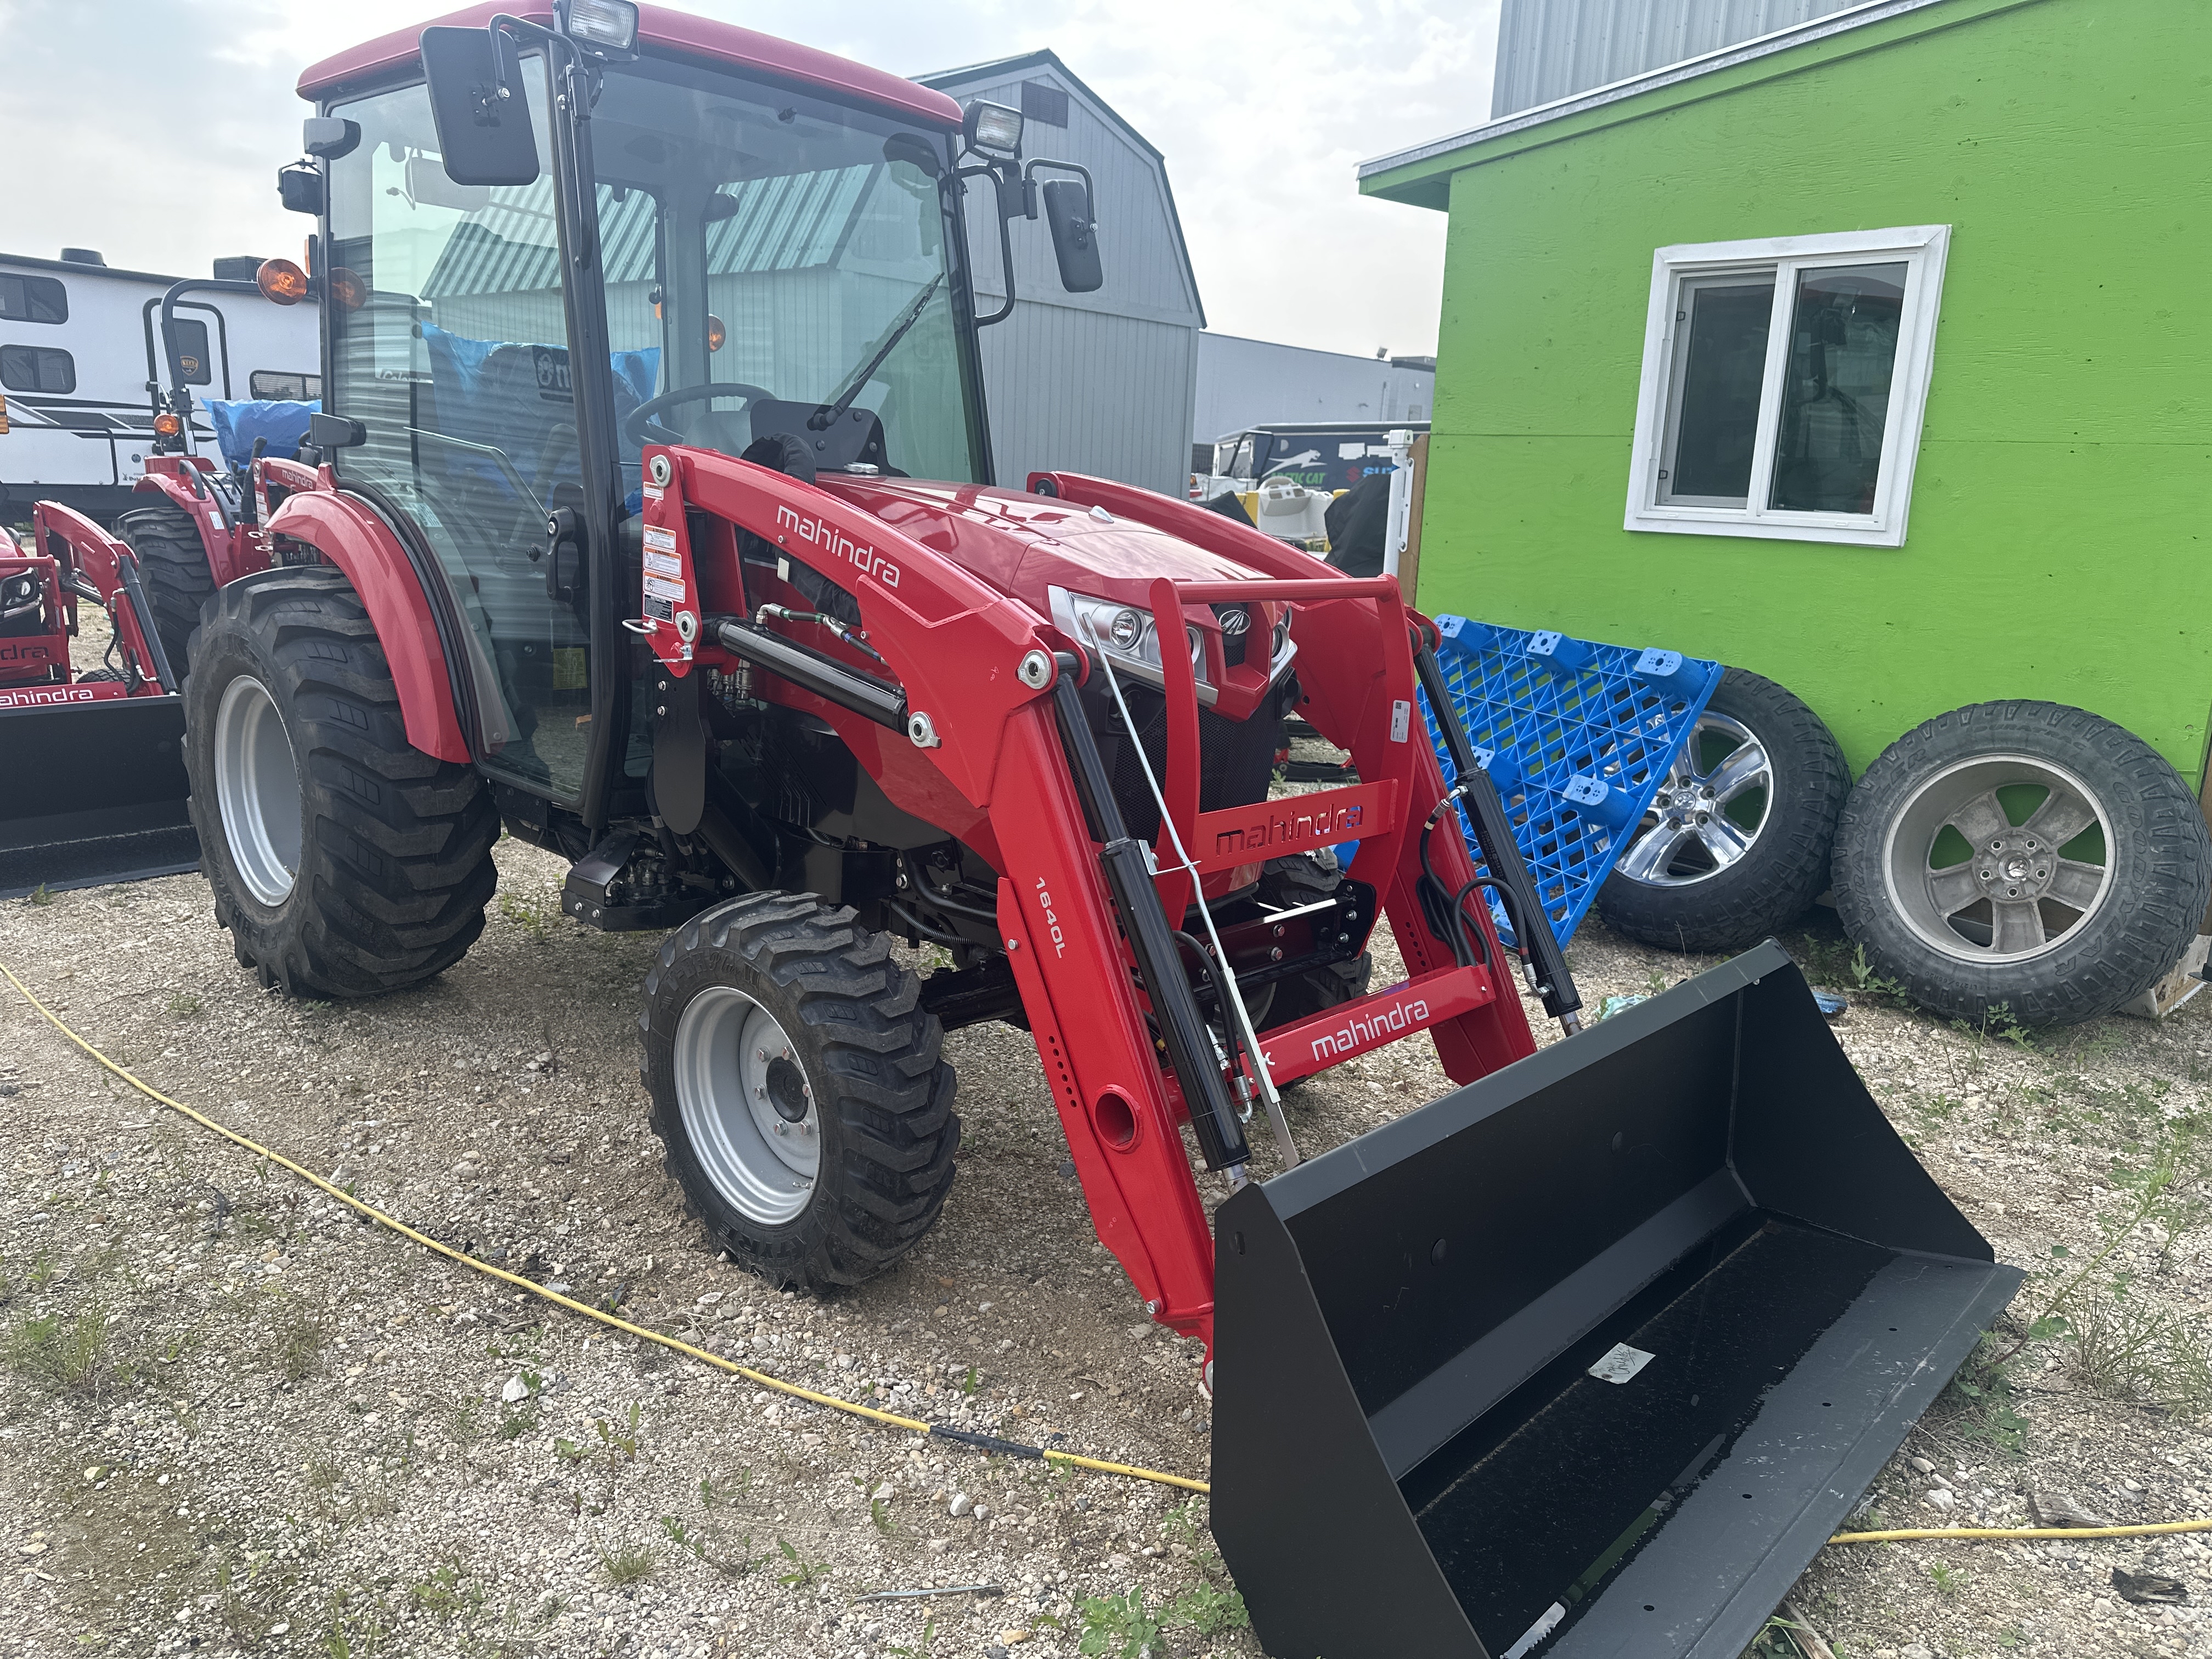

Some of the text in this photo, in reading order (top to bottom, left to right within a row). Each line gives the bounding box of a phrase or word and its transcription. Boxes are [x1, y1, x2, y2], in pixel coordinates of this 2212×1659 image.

[282, 469, 313, 490] mahindra
[1306, 472, 1325, 484] CAT
[777, 504, 900, 588] mahindra
[0, 688, 93, 706] ahindra
[1216, 803, 1364, 858] mahindra
[1852, 748, 1926, 923] WRANGLER
[2055, 782, 2148, 977] GOODYEAR
[1036, 876, 1065, 959] 1640L
[1311, 1000, 1430, 1061] mahindra
